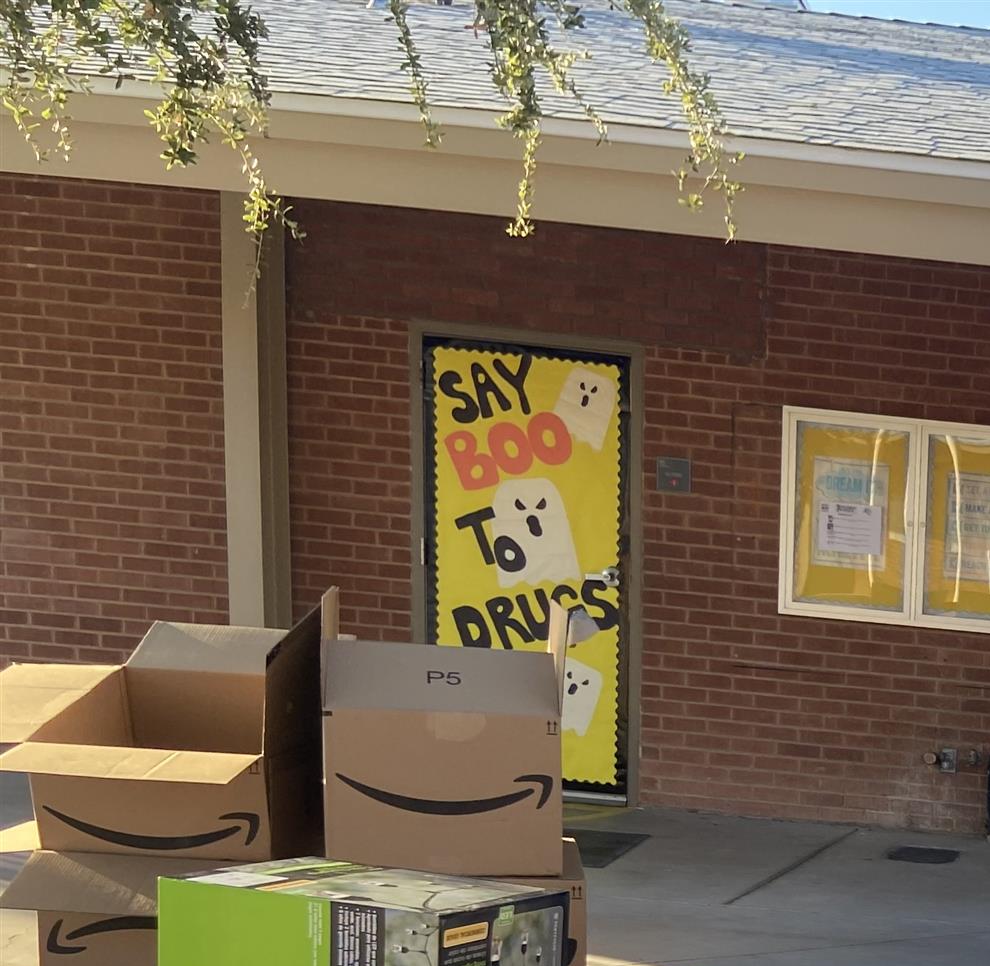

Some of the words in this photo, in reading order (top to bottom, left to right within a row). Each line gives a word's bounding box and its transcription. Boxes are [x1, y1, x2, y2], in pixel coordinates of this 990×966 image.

[439, 354, 532, 424] SAY
[445, 412, 572, 491] BOO
[455, 507, 527, 573] TO
[426, 670, 462, 686] P5
